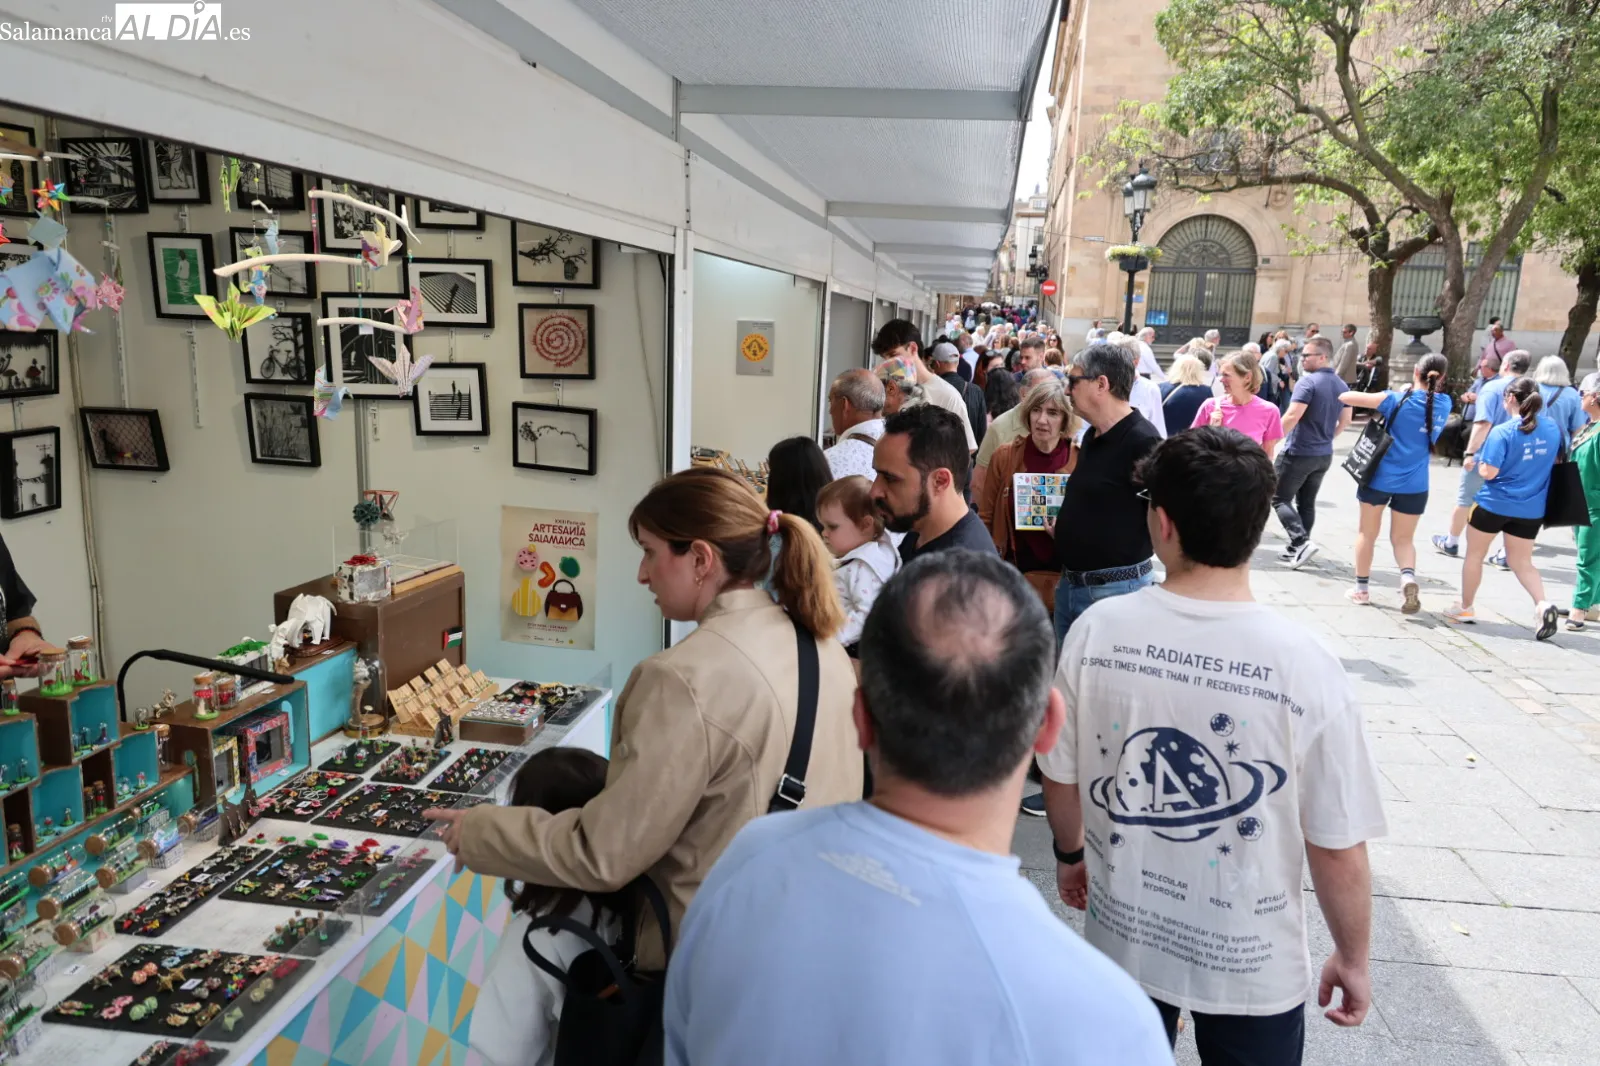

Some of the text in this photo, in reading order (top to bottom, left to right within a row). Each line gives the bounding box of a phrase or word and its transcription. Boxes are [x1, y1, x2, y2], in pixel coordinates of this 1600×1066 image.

[528, 533, 586, 547] SALAMANCA
[1113, 644, 1273, 682] SATURN RADIATES HEAT
[1089, 657, 1112, 669] SPACE
[1114, 660, 1137, 672] TIMES
[1139, 664, 1164, 678] MORE
[1166, 669, 1190, 684] THAN
[1193, 675, 1203, 686] IT
[1206, 678, 1251, 696] RECEIVES
[1252, 687, 1279, 702] FROM
[1141, 869, 1188, 890] MOLECULAR
[1143, 881, 1186, 901] HYDROGEN
[1209, 897, 1232, 910] ROCK
[1109, 895, 1135, 912] famous
[1137, 906, 1148, 916] for
[1150, 911, 1160, 920] its
[1162, 916, 1209, 936] spectacular
[1211, 931, 1229, 944] ring
[1127, 915, 1136, 924] of
[1138, 919, 1176, 937] individual
[1177, 932, 1214, 949] particles
[1215, 944, 1225, 952] of
[1226, 945, 1239, 954] ice
[1240, 945, 1256, 954] and
[1130, 935, 1140, 945] its
[1142, 940, 1160, 950] own
[1161, 944, 1208, 969] atmosphere
[1210, 964, 1226, 973] and
[1228, 966, 1262, 974] weather
[1171, 940, 1194, 954] moon
[1195, 948, 1203, 957] in
[1205, 950, 1219, 961] the
